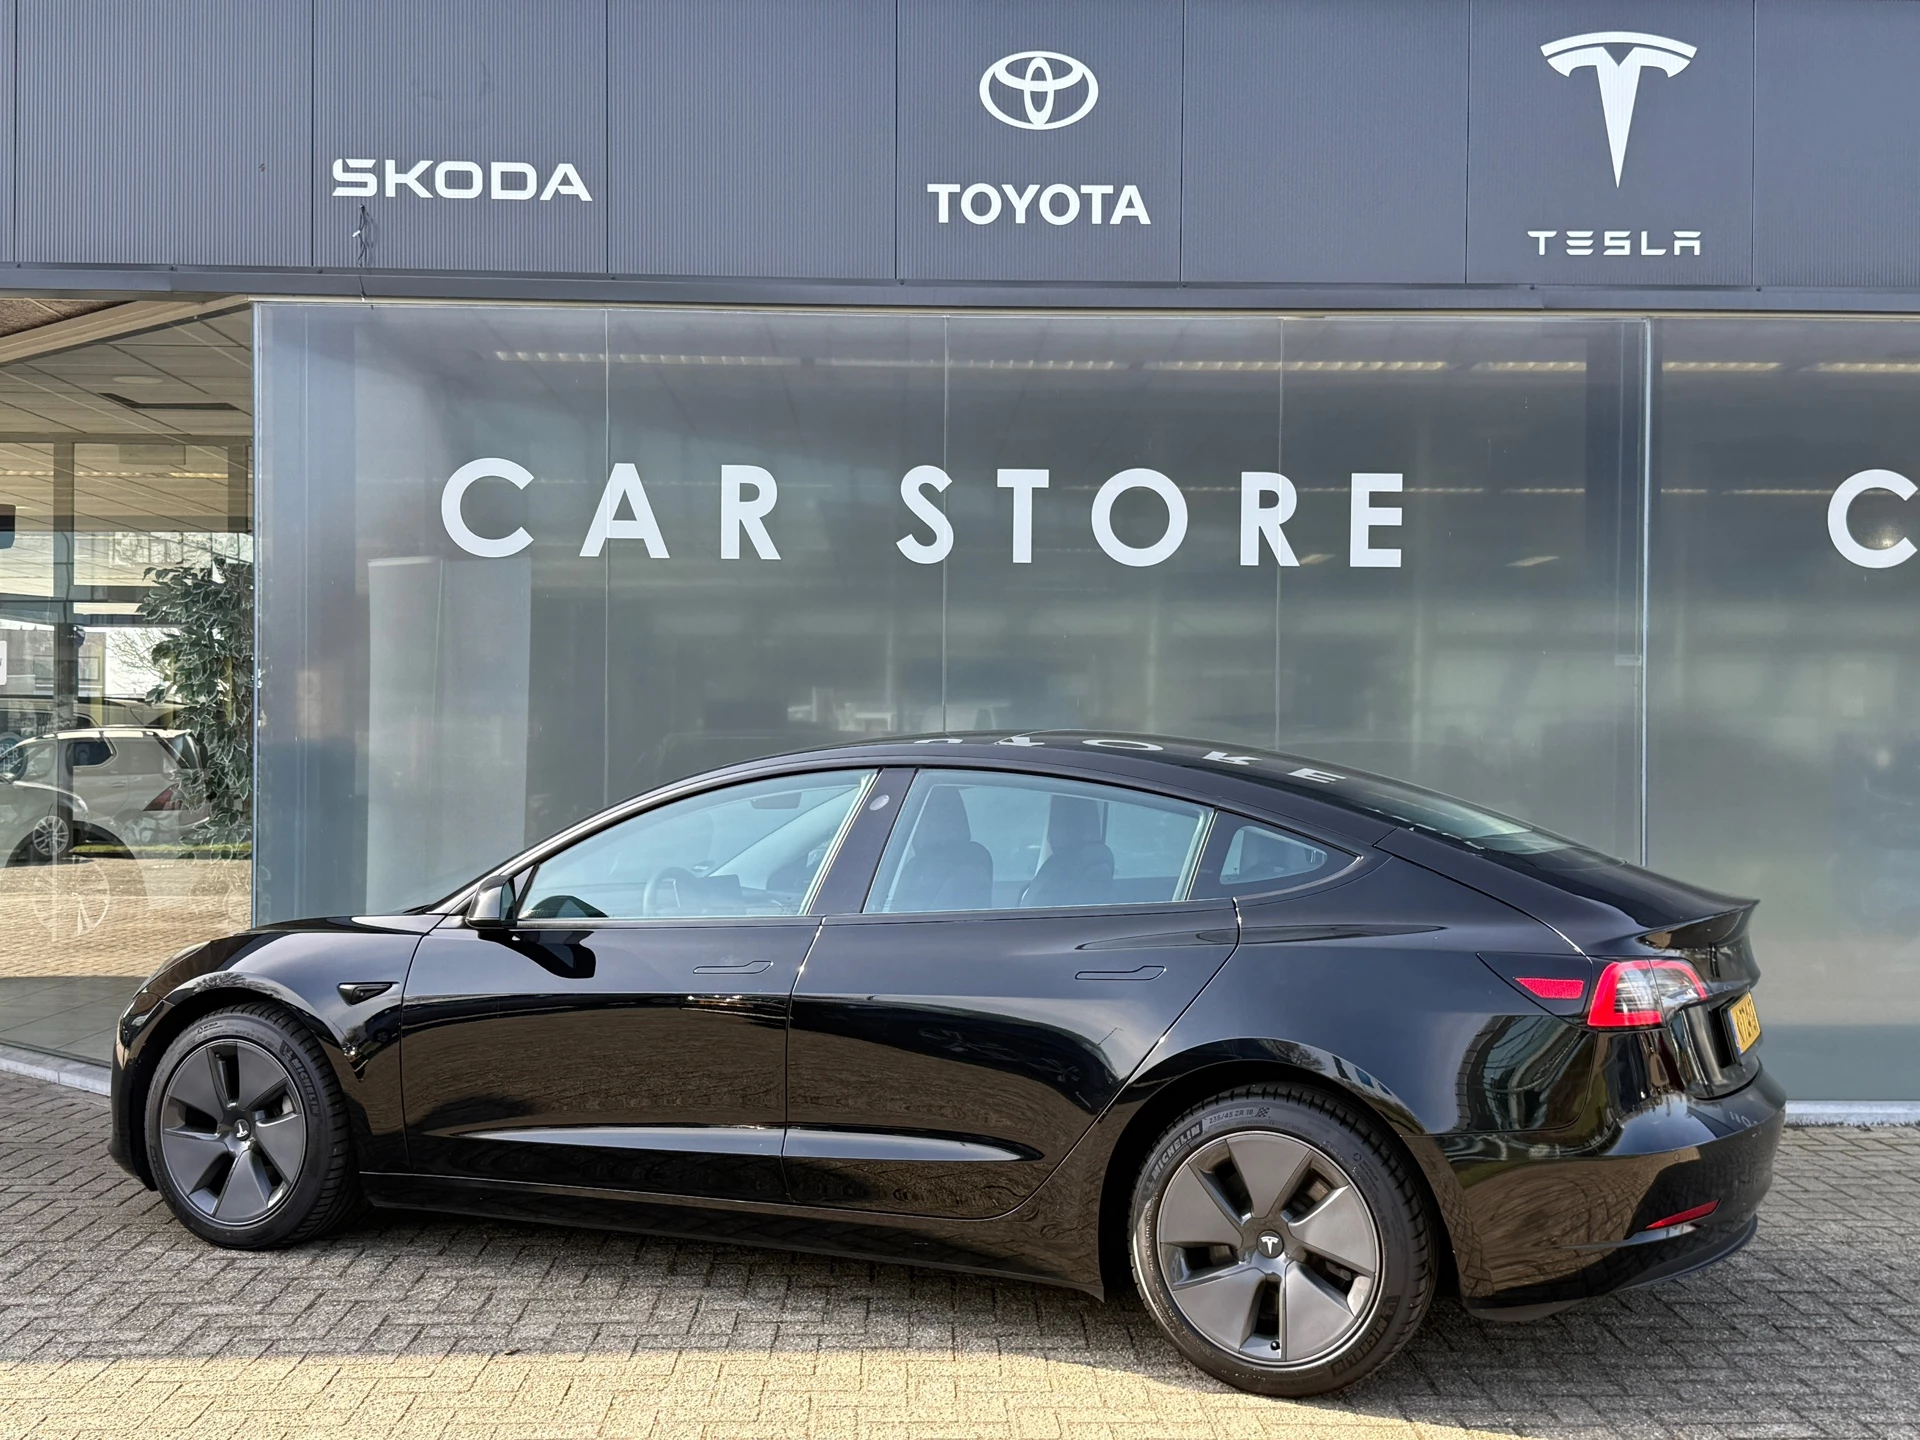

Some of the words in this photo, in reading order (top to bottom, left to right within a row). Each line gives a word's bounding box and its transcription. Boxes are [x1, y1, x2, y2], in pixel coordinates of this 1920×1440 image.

[927, 182, 1152, 226] TOYOTA
[1527, 230, 1701, 256] TESLA
[441, 457, 781, 560] CAR
[896, 465, 1403, 568] STORE
[1827, 468, 1919, 569] C
[291, 1057, 320, 1115] MICHELIN
[1208, 1111, 1233, 1124] 235/45
[1151, 1124, 1201, 1181] MICHELIN
